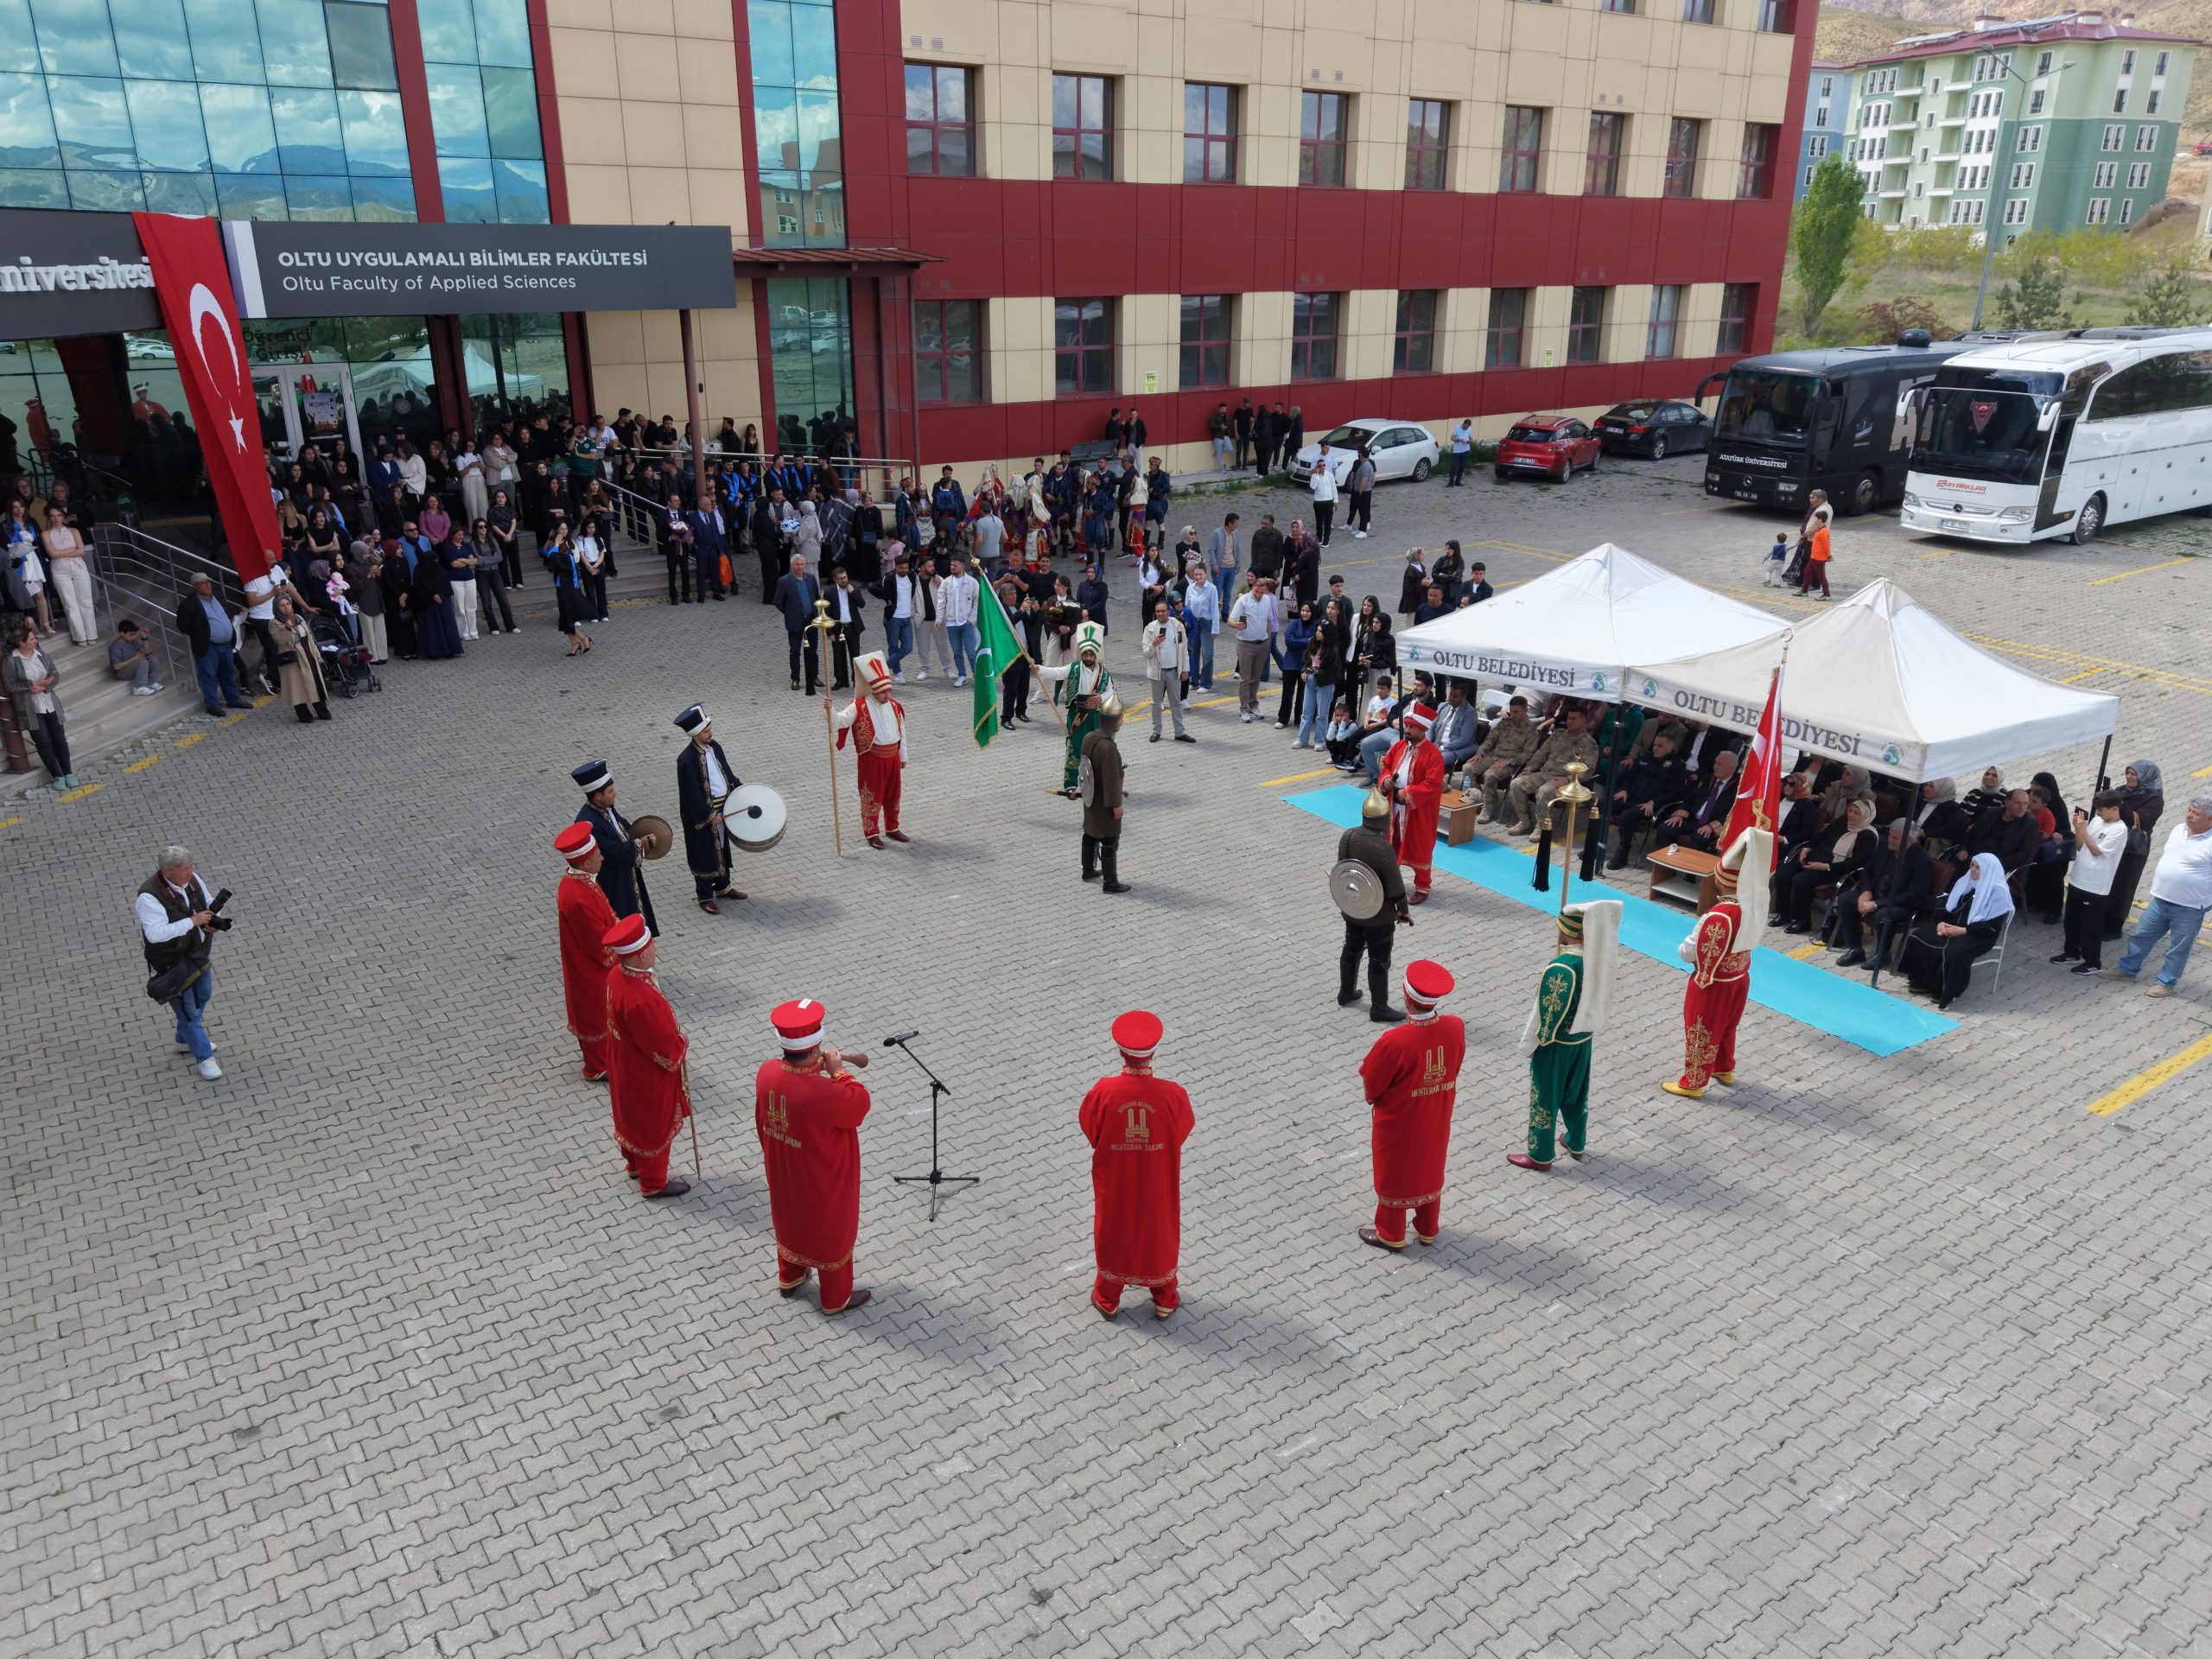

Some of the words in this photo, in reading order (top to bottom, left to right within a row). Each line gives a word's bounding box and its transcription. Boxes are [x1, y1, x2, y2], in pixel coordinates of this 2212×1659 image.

[278, 251, 332, 266] OLTU
[336, 251, 466, 266] UYGULAMALI
[470, 249, 552, 266] BİLİMLER
[556, 249, 648, 266] FAKÜLTESİ
[283, 276, 324, 291] Oltu
[330, 275, 398, 293] Faculty
[404, 275, 423, 290] of
[429, 275, 499, 292] Applied
[504, 274, 576, 289] Sciences
[242, 327, 312, 346] Öğrenci
[1719, 454, 1745, 463] ATATÜRK
[1745, 456, 1788, 468] ÜNİVERSİTESİ
[1936, 480, 1987, 493] BAYRAKLAR
[1433, 651, 1474, 671] OLTU
[1478, 657, 1576, 688] BELEDİYESİ
[1674, 690, 1727, 718] OLTU
[1731, 704, 1862, 756] BEDİYESİ
